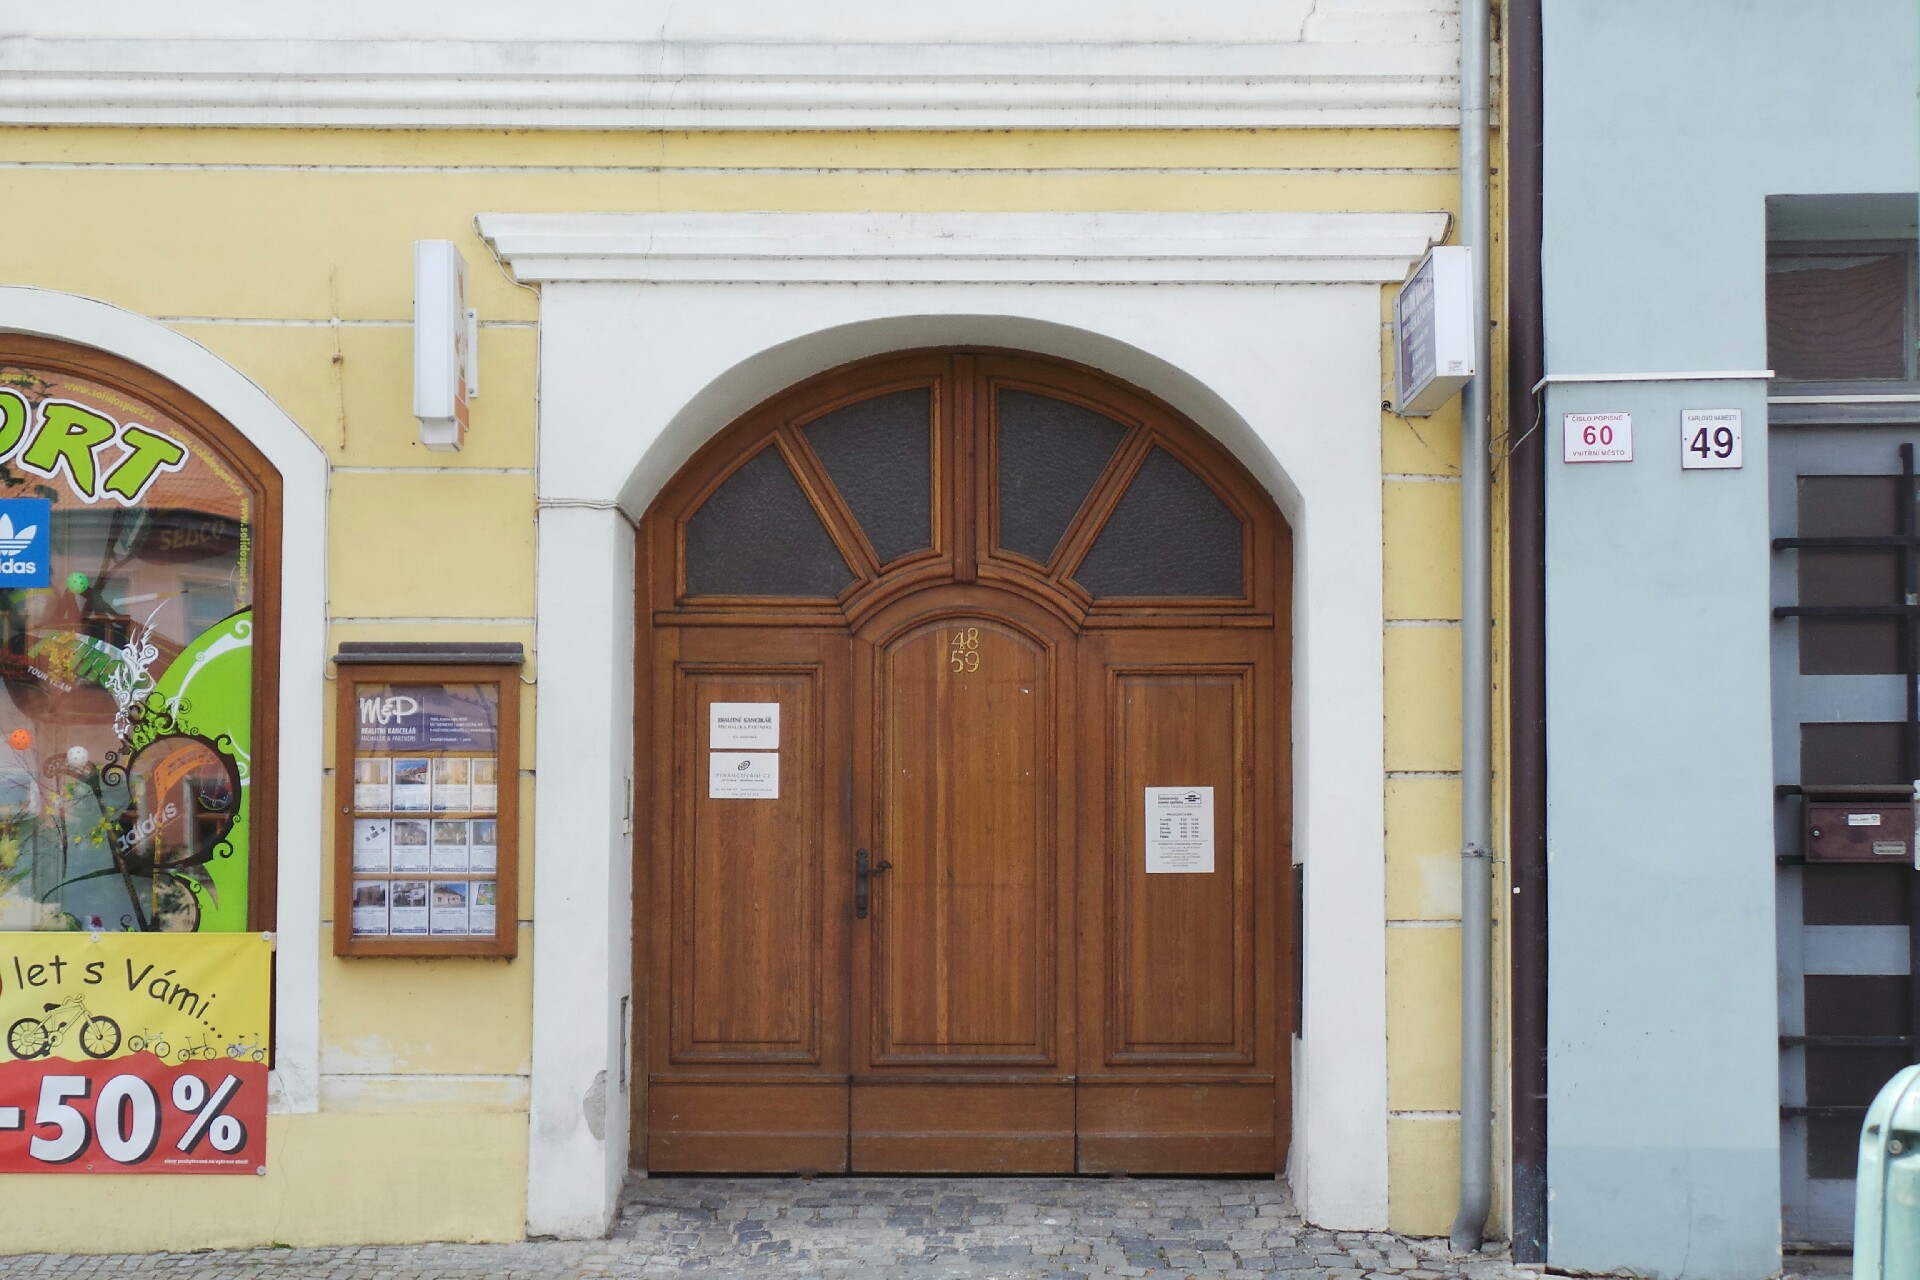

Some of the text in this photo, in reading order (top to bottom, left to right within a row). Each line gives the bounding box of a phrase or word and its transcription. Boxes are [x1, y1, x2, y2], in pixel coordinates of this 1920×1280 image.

[1593, 414, 1624, 422] POPISNÉ
[1583, 425, 1613, 446] 60
[1690, 426, 1734, 459] 49
[1572, 449, 1625, 457] VNITŘNÍ MĚSTO
[951, 627, 979, 650] 48
[950, 651, 980, 673] 59
[27, 665, 49, 681] TOUR
[13, 955, 223, 1039] let s Vámi...
